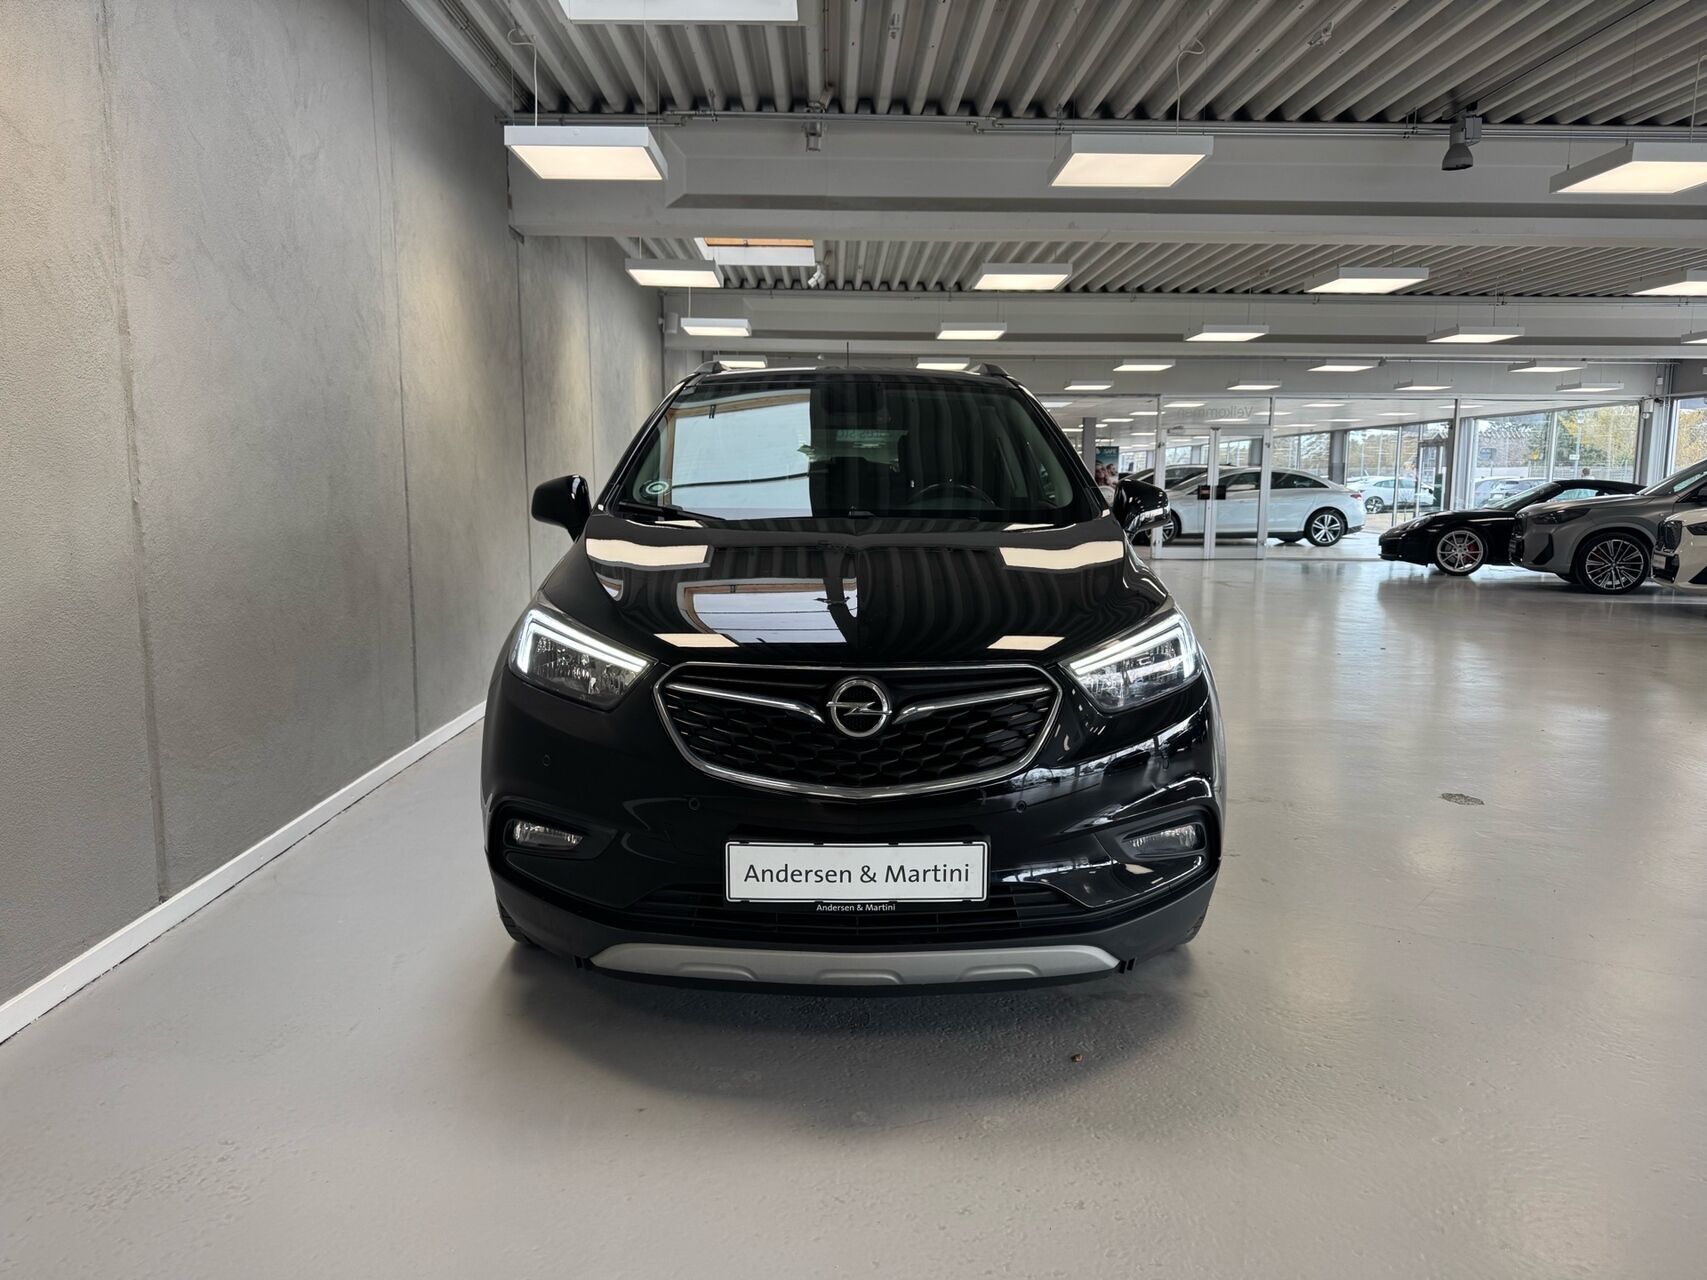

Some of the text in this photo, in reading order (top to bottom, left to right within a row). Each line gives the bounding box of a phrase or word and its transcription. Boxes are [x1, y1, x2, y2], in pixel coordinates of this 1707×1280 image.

[743, 863, 970, 884] Andersen & Martini
[816, 903, 896, 912] Andersen & Martini
